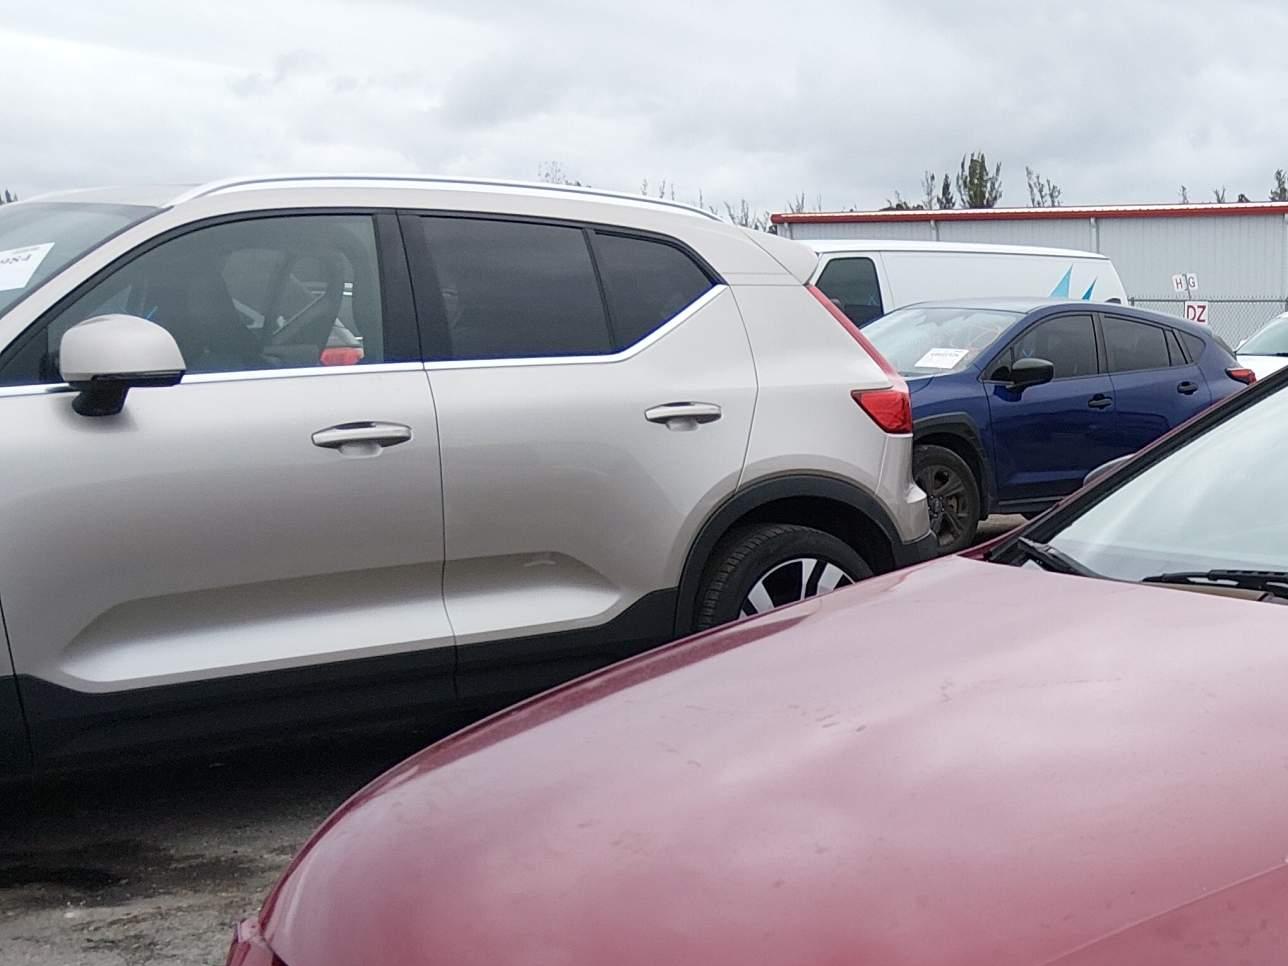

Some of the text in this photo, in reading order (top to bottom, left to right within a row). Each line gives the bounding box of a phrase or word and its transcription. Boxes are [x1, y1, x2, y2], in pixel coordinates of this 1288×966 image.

[1175, 278, 1183, 289] H
[1188, 276, 1196, 288] G
[1187, 305, 1206, 322] DZ
